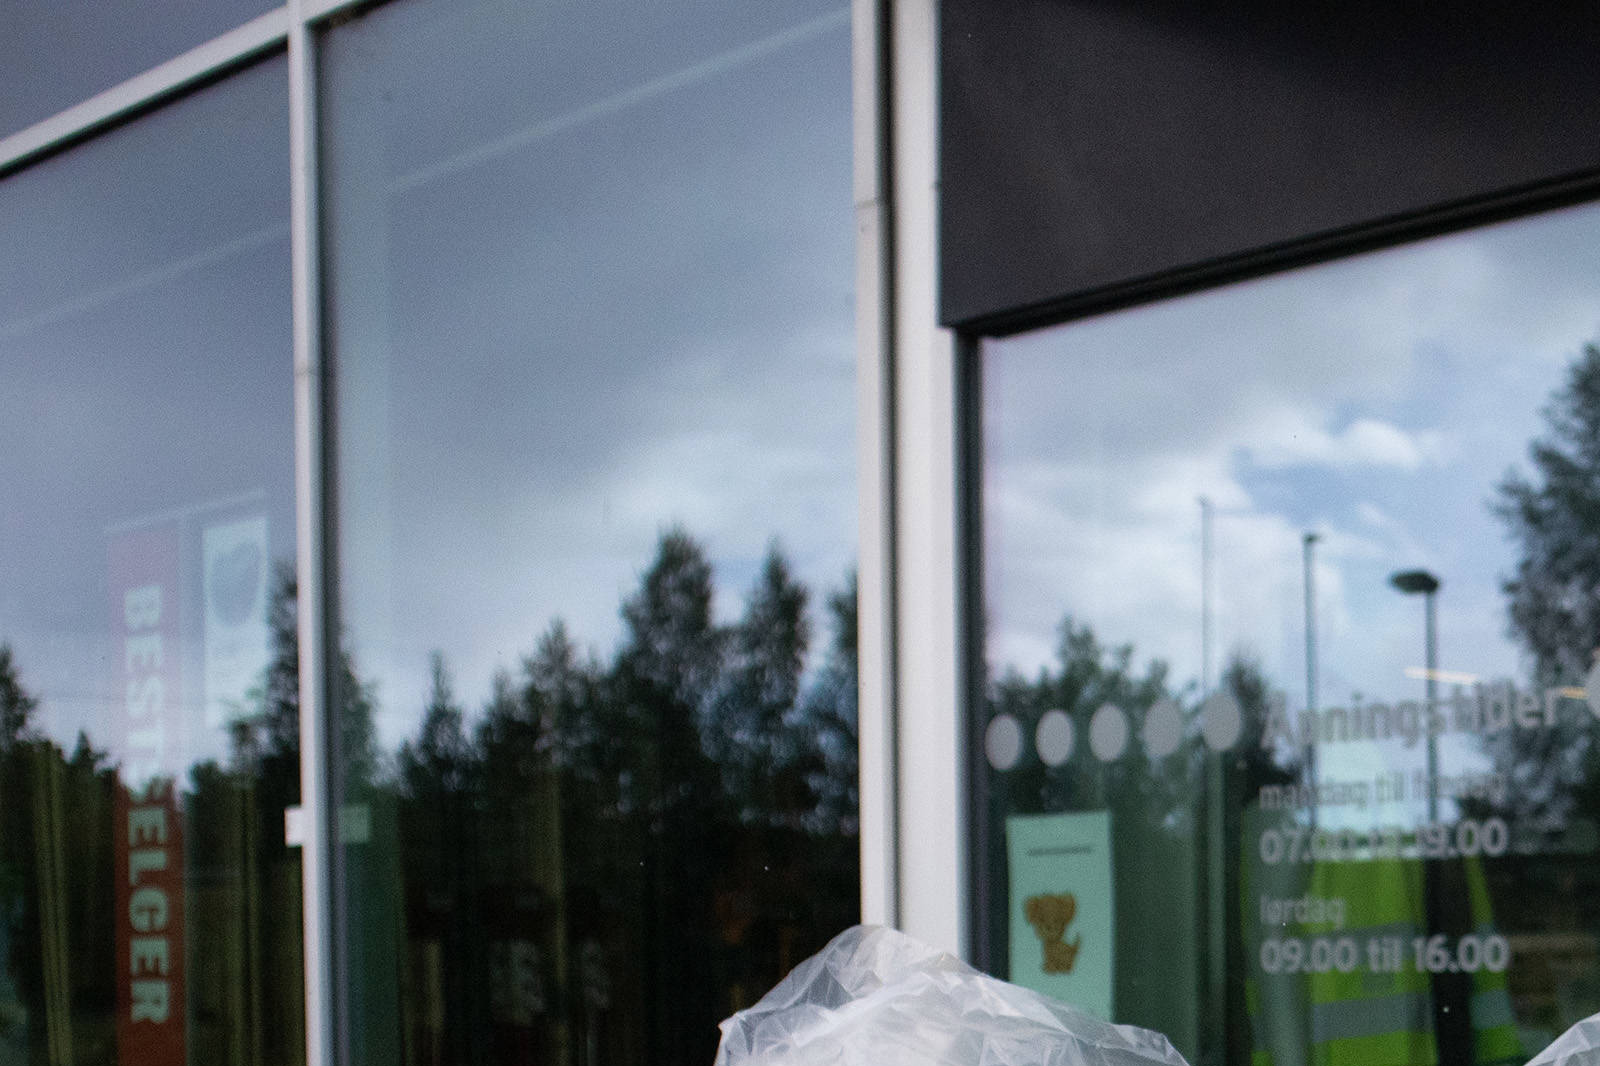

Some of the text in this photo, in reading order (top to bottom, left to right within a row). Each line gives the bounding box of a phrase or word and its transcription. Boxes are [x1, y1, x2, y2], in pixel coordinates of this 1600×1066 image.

[1258, 932, 1511, 974] 09.00 til 16.00
